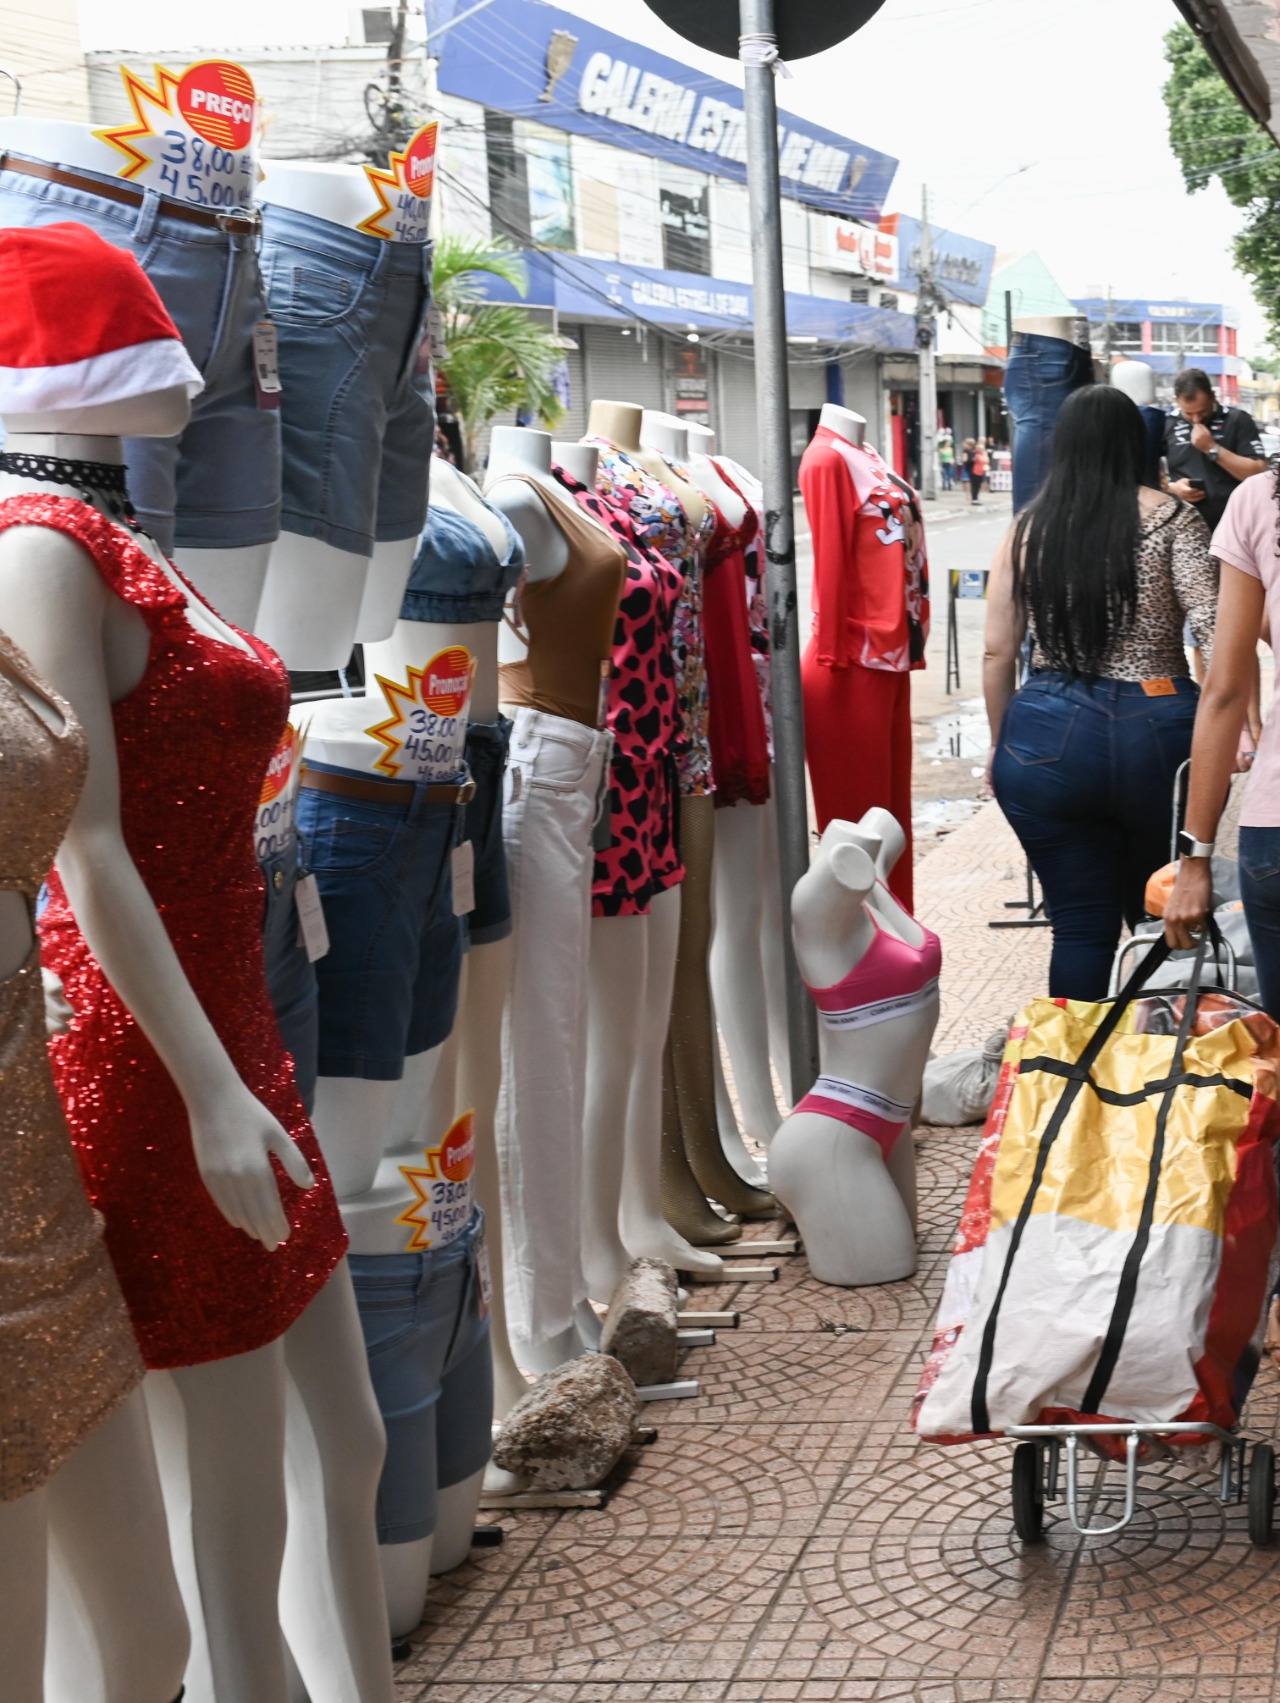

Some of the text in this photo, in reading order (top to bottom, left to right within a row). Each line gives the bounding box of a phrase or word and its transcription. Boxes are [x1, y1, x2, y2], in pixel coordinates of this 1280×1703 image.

[190, 88, 252, 125] PREÇO
[579, 52, 697, 144] GALERIA
[160, 130, 235, 177] 38,00
[160, 164, 235, 207] 45,00
